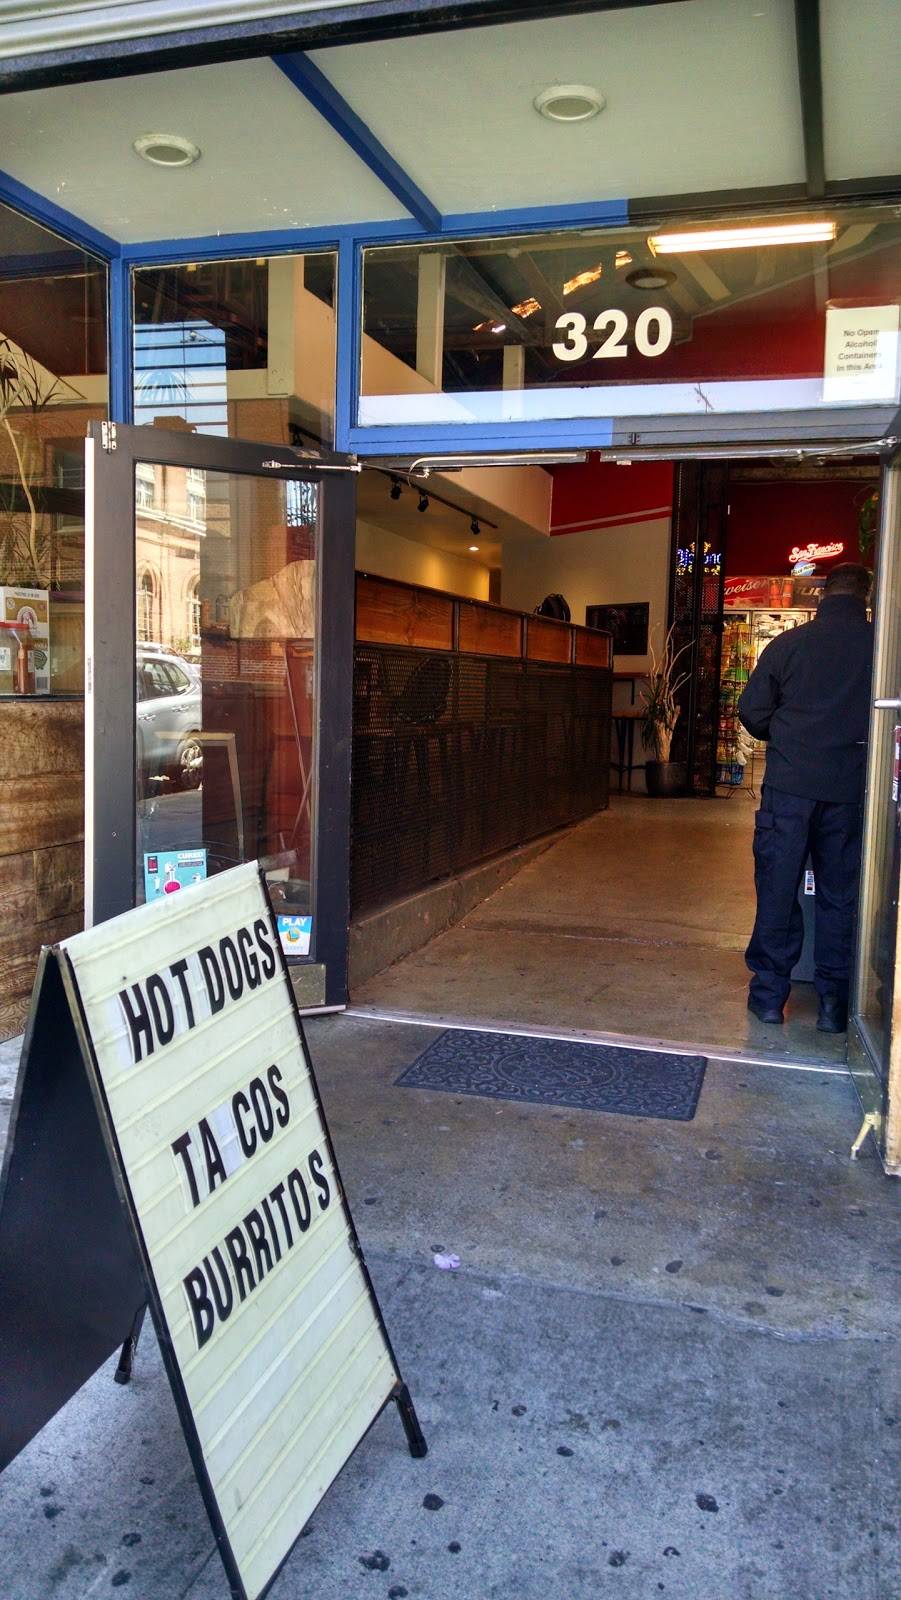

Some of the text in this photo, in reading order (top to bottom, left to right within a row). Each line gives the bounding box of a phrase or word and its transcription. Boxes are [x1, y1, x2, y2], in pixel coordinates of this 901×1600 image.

[552, 306, 673, 361] 320
[846, 340, 877, 348] Alcohol
[282, 918, 307, 927] PLAY
[120, 918, 276, 1063] HOT DOGS
[183, 1149, 331, 1350] BURRITOS
